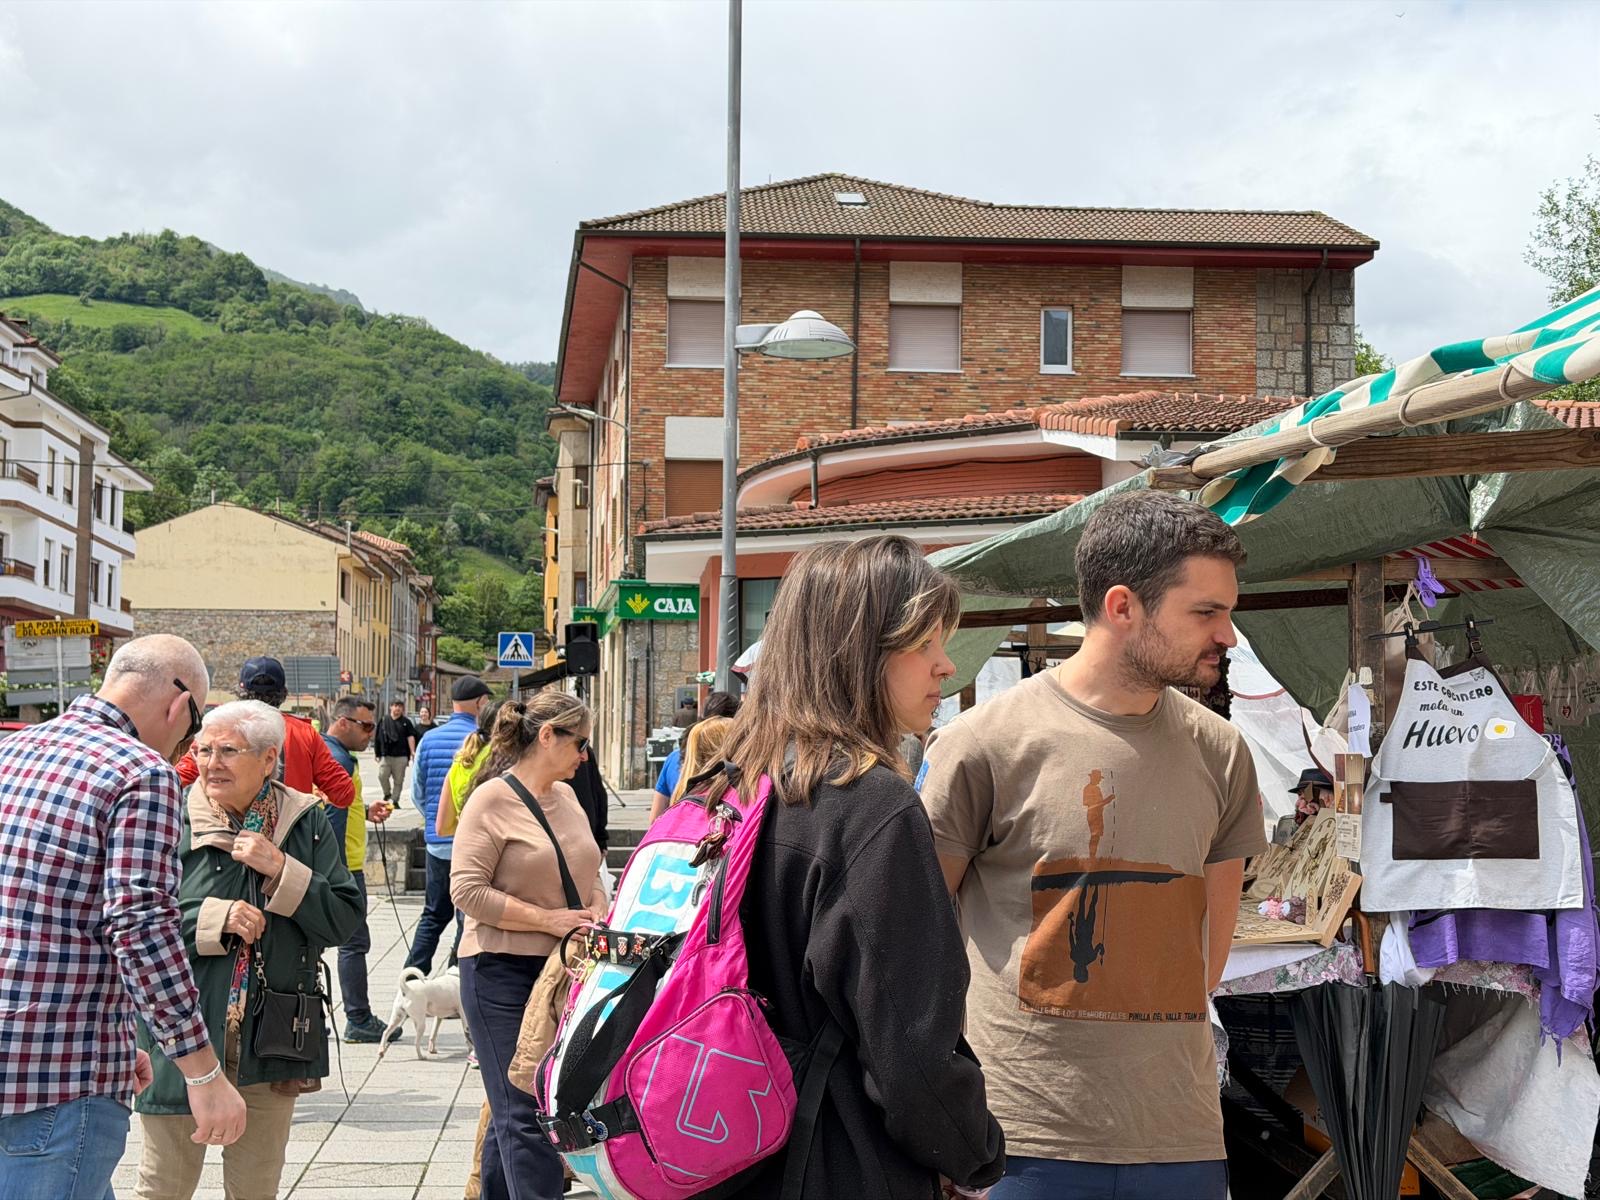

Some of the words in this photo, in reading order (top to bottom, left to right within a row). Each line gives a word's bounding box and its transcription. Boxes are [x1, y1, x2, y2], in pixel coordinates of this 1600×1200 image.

[653, 597, 696, 614] CAJA
[22, 622, 34, 630] LA
[36, 621, 66, 629] POSTA
[22, 629, 38, 637] DEL
[1413, 680, 1440, 692] ESTE
[1419, 699, 1449, 712] mola
[1451, 708, 1465, 717] un
[1402, 719, 1479, 750] Huevo
[1051, 1007, 1061, 1016] DE
[1062, 1008, 1075, 1018] LOS
[1128, 1012, 1151, 1021] PINILLA
[1152, 1012, 1163, 1021] DEL
